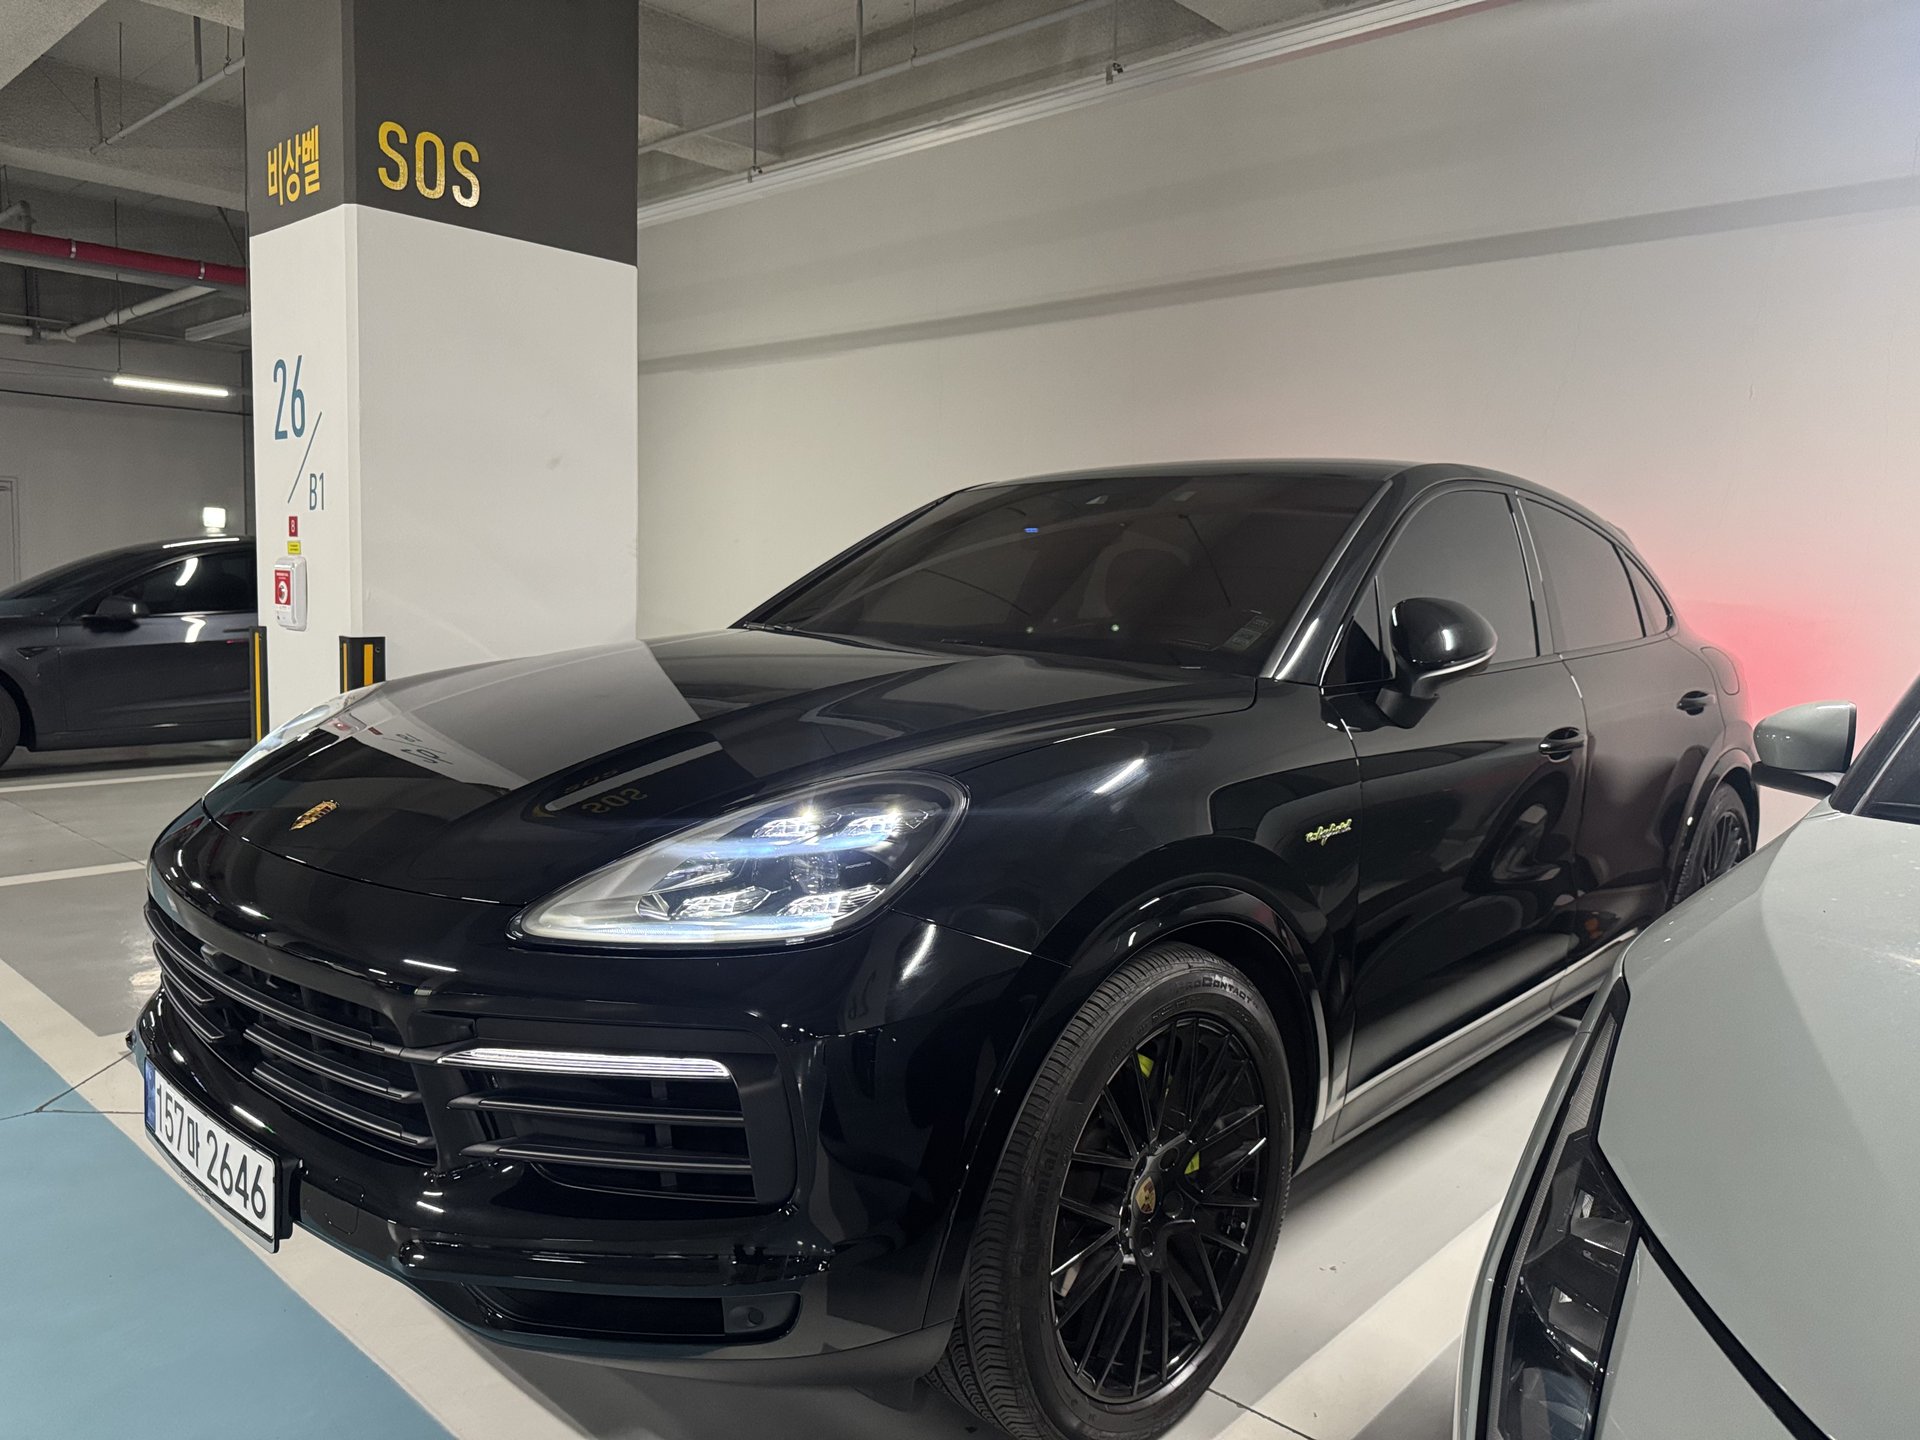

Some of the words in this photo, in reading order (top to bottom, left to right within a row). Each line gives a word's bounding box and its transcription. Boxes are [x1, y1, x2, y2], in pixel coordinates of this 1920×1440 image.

[267, 124, 321, 206] 비상벨
[378, 121, 480, 208] SOS
[273, 355, 306, 440] 26
[309, 472, 325, 511] B1
[157, 1084, 201, 1168] 157마
[206, 1129, 267, 1220] 2646
